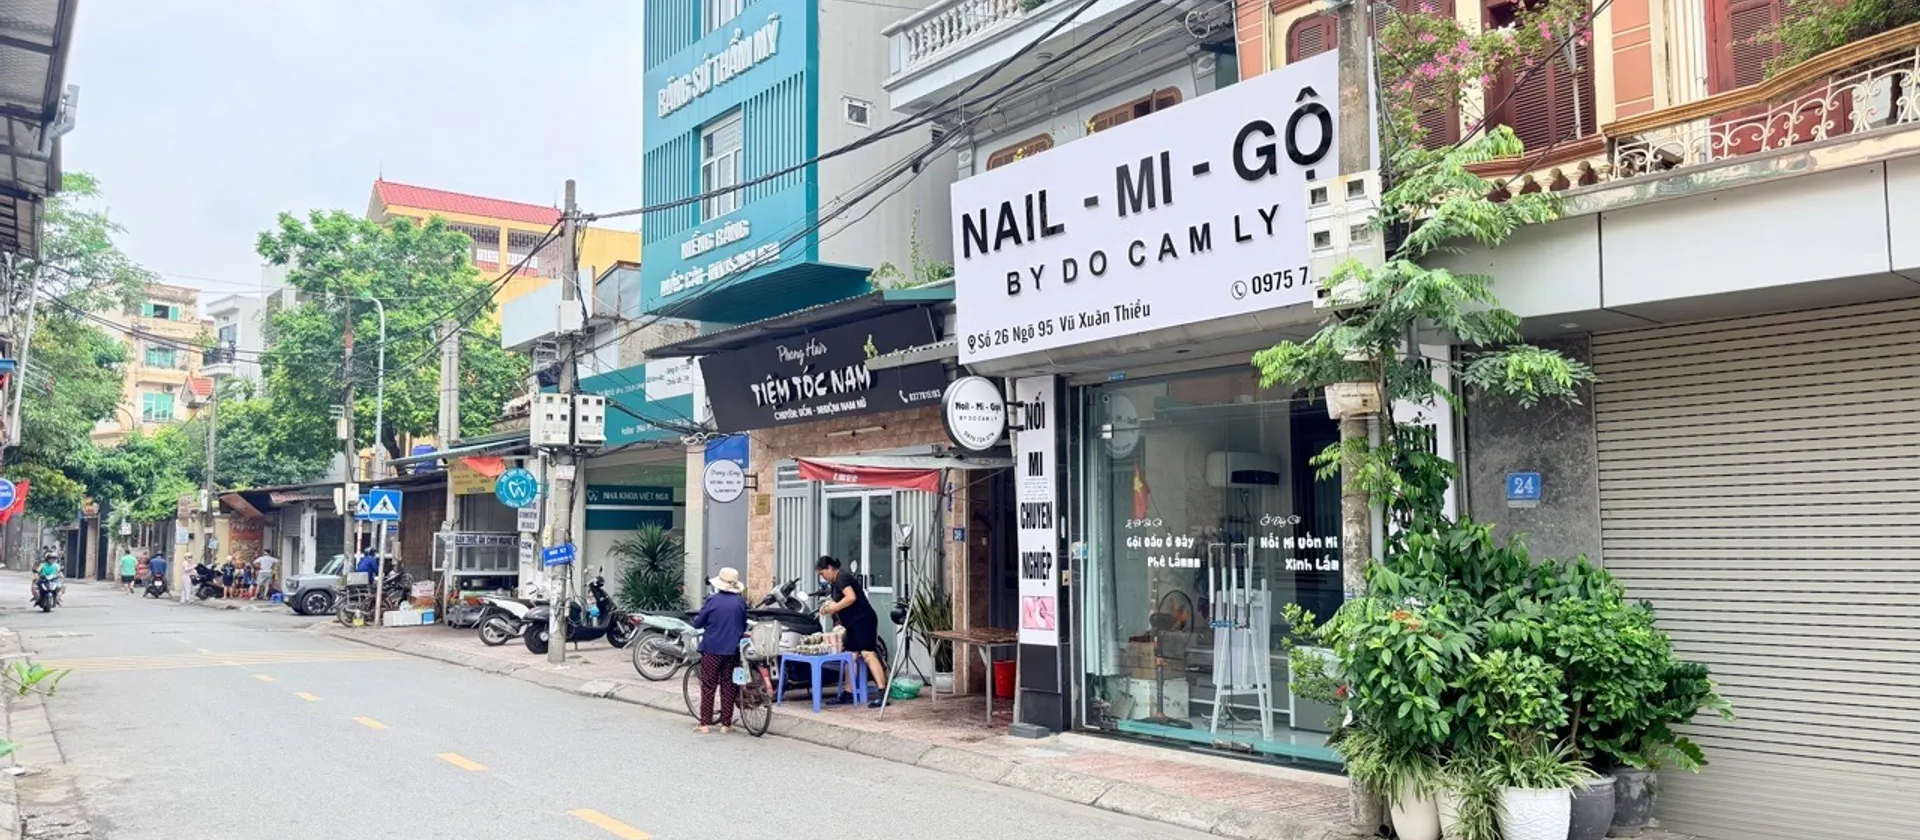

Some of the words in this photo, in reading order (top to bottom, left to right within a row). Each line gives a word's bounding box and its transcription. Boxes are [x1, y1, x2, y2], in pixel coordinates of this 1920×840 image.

[962, 189, 1065, 259] NAIL
[1115, 150, 1174, 218] MI
[1232, 85, 1333, 182] GỘ
[1007, 263, 1044, 296] BY
[1062, 250, 1107, 285] DO
[1128, 222, 1212, 267] CAM
[1234, 204, 1280, 243] LY
[1252, 268, 1294, 296] 0975
[978, 330, 991, 349] Số
[994, 329, 1009, 346] 26
[1013, 324, 1035, 343] Ngõ
[1038, 319, 1054, 337] 95
[1059, 315, 1075, 332] Vũ
[1079, 309, 1110, 328] Xuân
[751, 373, 790, 410] TIỆM
[792, 365, 827, 400] TÓC
[830, 364, 871, 394] NAM
[1024, 391, 1046, 431] NỐI
[1028, 451, 1043, 477] MI
[1514, 476, 1534, 495] 24
[1126, 535, 1141, 550] Gội
[1144, 533, 1163, 548] Đầu
[1175, 534, 1194, 549] Đây
[1325, 536, 1338, 548] Mi
[1022, 545, 1053, 587] NGHIỆP
[1147, 554, 1166, 568] Phê
[1285, 558, 1312, 571] Xinh
[1315, 554, 1339, 571] Lắm
